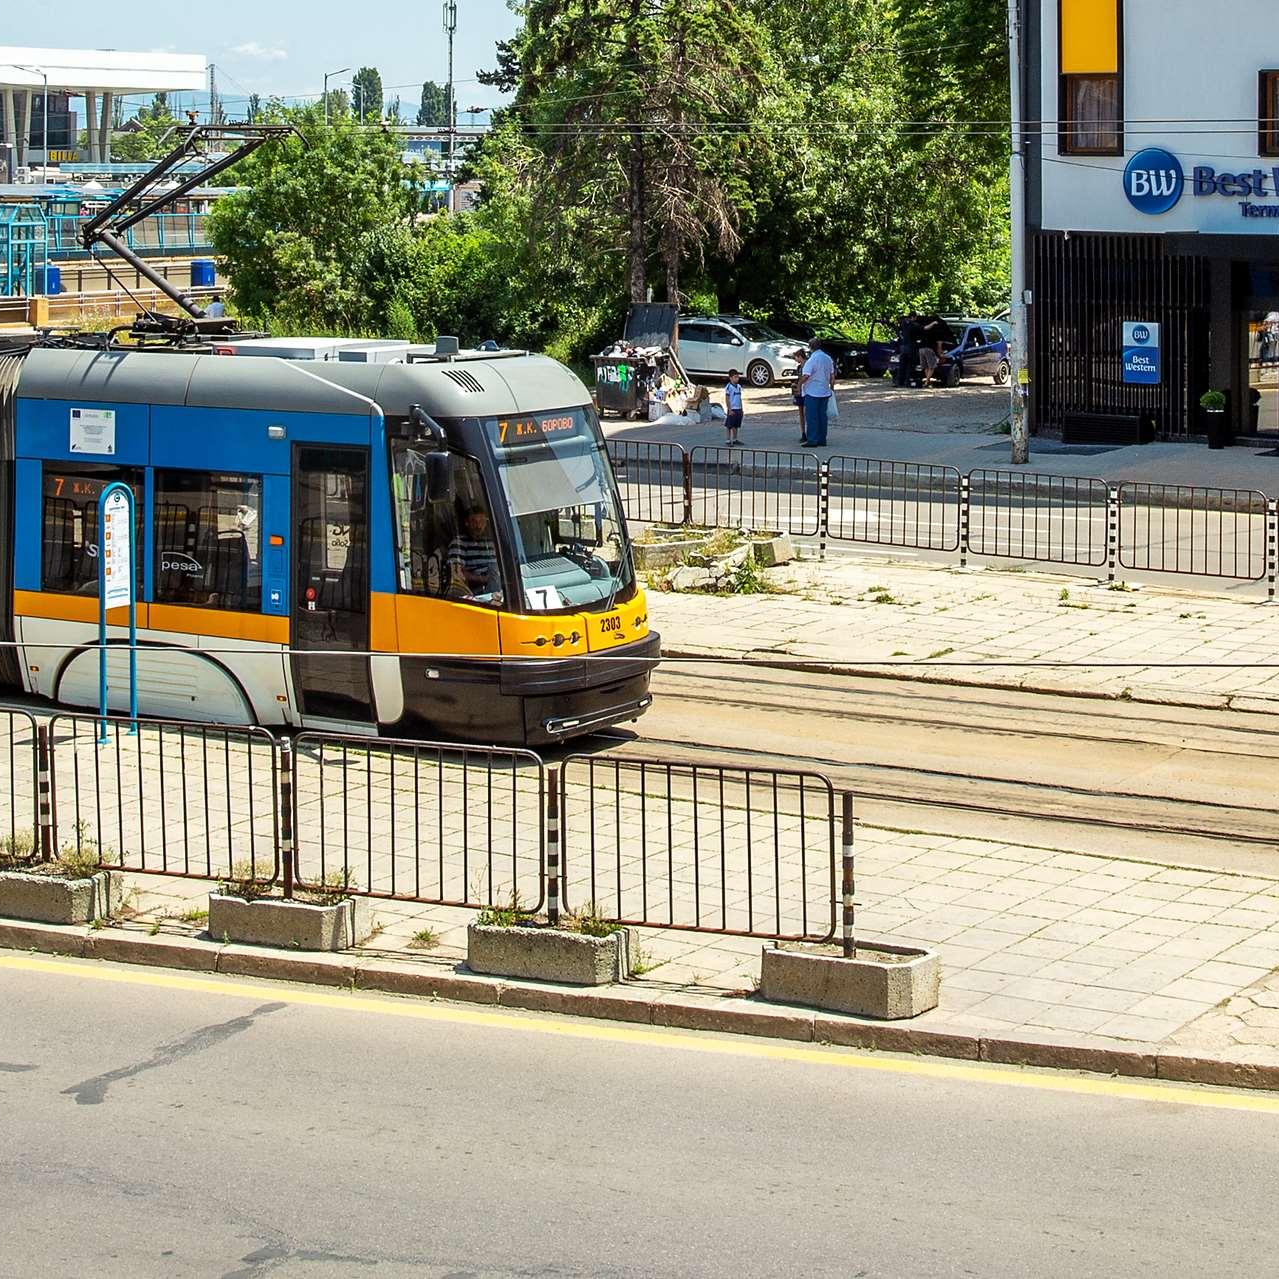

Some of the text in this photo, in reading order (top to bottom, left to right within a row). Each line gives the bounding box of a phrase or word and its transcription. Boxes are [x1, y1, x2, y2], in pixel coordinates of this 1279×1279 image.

[1130, 169, 1176, 196] BW
[1192, 166, 1268, 198] Best
[1125, 362, 1156, 373] Western
[1132, 355, 1150, 365] Best
[499, 422, 508, 443] 7
[542, 416, 573, 433] БОРОВО
[55, 478, 64, 497] 7
[161, 561, 198, 572] pesa
[535, 589, 548, 609] 7
[600, 616, 621, 632] 2303
